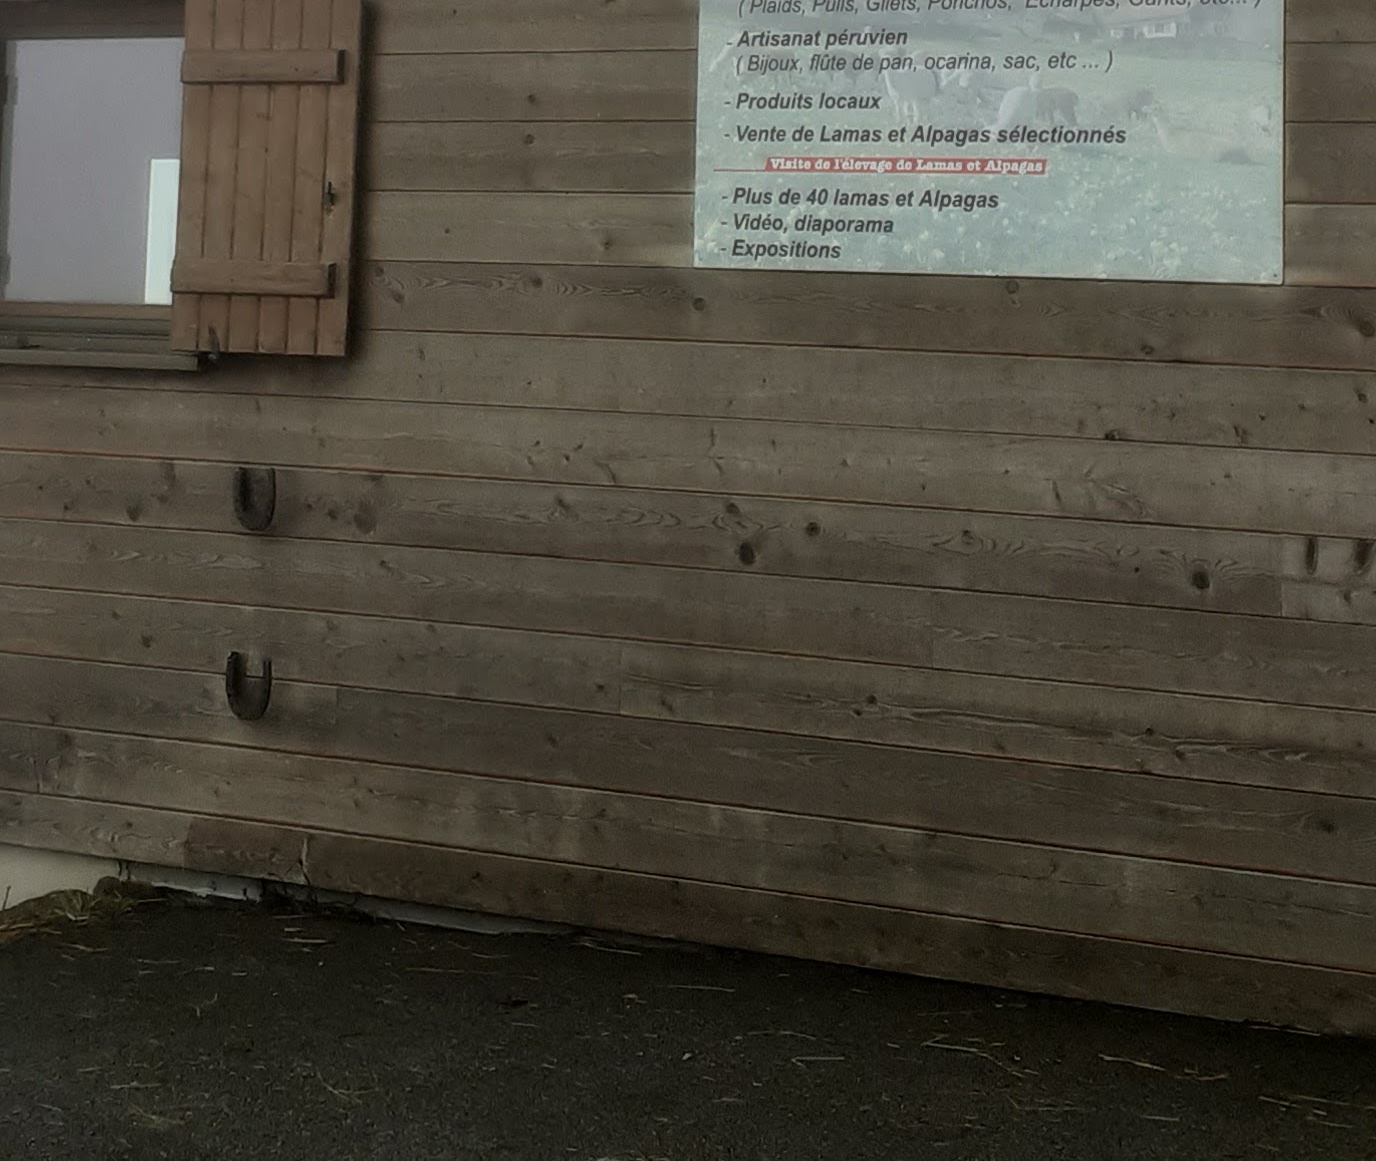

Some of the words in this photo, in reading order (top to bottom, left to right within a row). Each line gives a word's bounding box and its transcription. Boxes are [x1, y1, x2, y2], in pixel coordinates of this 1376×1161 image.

[737, 31, 821, 47] Artisanat
[825, 28, 908, 50] péruvien
[747, 55, 803, 75] Bijoux,
[809, 53, 847, 71] flûte
[852, 54, 874, 71] de
[879, 56, 917, 74] pan,
[924, 52, 996, 72] ocarina,
[1003, 54, 1040, 72] sac,
[736, 93, 813, 109] Produits
[819, 93, 882, 109] locaux
[736, 125, 786, 142] Vente
[792, 125, 814, 142] de
[820, 125, 882, 143] Lamas
[888, 127, 906, 143] et
[910, 125, 990, 147] Alpagas
[997, 125, 1127, 144] sélectionnés
[770, 158, 811, 170] Visite
[814, 158, 830, 171] de
[833, 157, 892, 173] l'élevage
[896, 159, 912, 171] de
[916, 160, 962, 172] Lamas
[967, 160, 981, 172] et
[984, 160, 1043, 175] Alpagas
[732, 187, 772, 205] Plus
[778, 188, 801, 205] de
[806, 189, 828, 206] 40
[833, 189, 889, 207] lamas
[895, 191, 914, 207] et
[918, 190, 999, 212] Alpagas
[733, 213, 788, 234] Vidéo,
[794, 215, 894, 237] diaporama
[731, 239, 841, 260] Expositions
